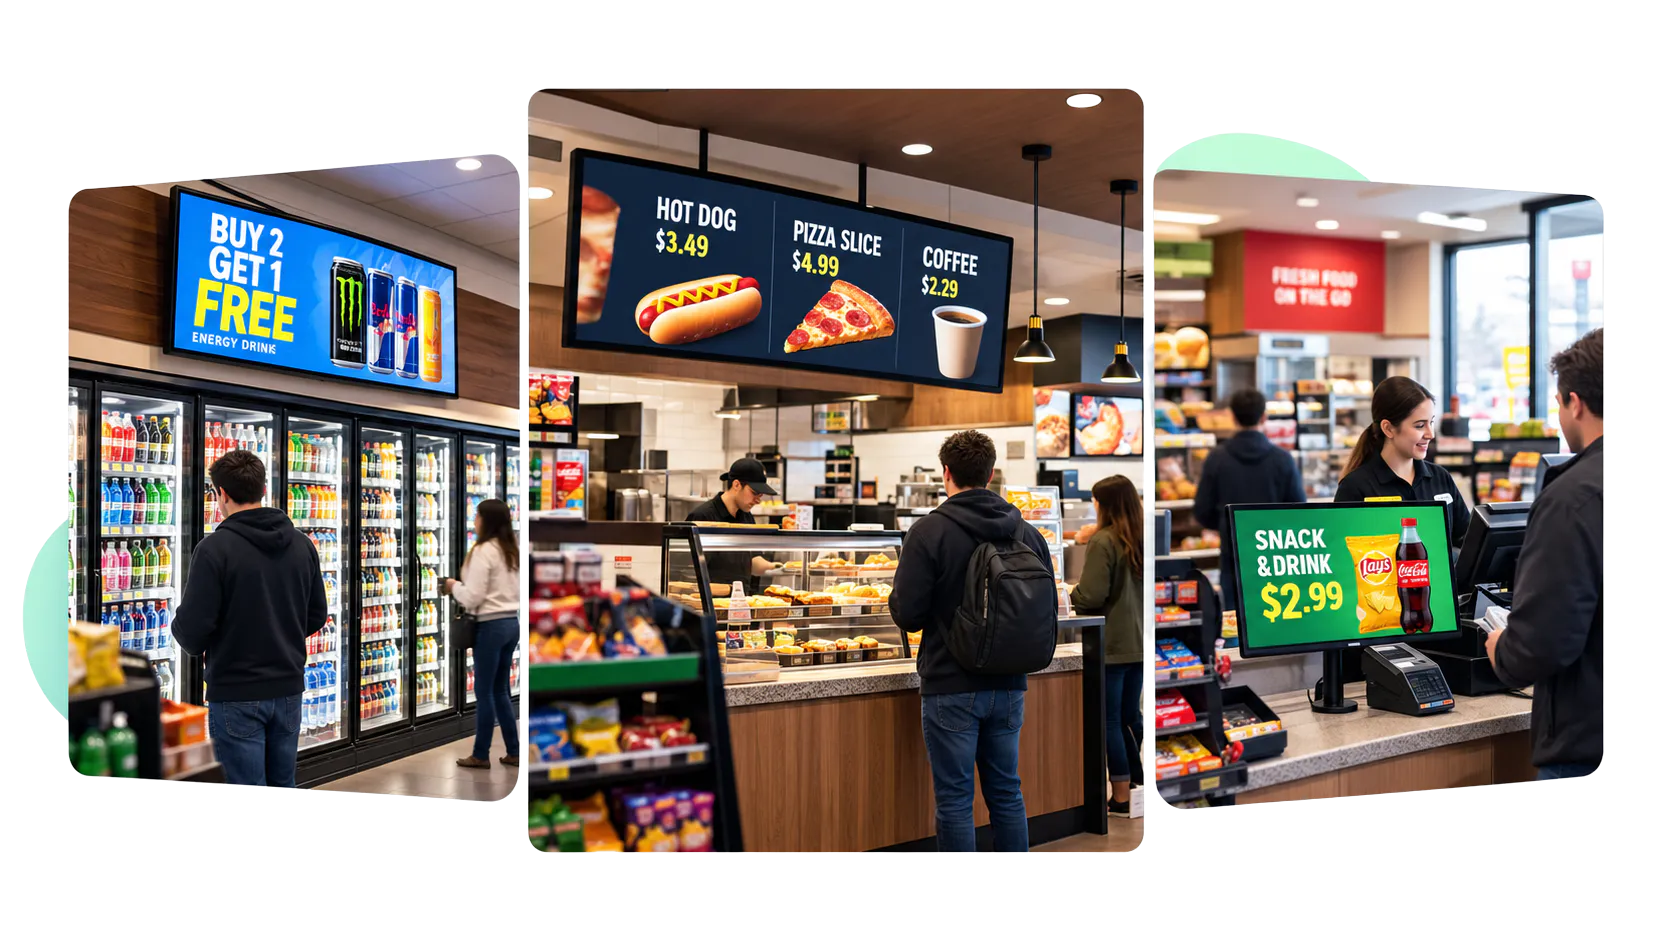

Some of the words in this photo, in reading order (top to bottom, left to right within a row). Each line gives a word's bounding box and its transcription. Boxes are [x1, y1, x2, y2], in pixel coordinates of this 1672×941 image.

[656, 195, 695, 224] HOT
[698, 203, 737, 232] DOG
[210, 212, 265, 252] BUY
[269, 227, 284, 258] 2
[655, 227, 709, 258] $3.49
[793, 219, 836, 249] PIZZA
[840, 229, 882, 257] SLICE
[208, 245, 265, 287] GET
[270, 260, 282, 292] 1
[792, 249, 839, 277] $4.99
[922, 245, 979, 276] COFFEE
[921, 274, 959, 299] $2.29
[1271, 265, 1320, 286] FRESH
[1321, 269, 1358, 289] FOOD
[193, 277, 298, 343] FREE
[1274, 286, 1297, 306] ON
[1299, 287, 1329, 307] THE
[1329, 289, 1352, 308] GO
[192, 332, 239, 348] ENERGY
[1255, 528, 1327, 551] SNACK
[1261, 580, 1344, 623] $2.99
